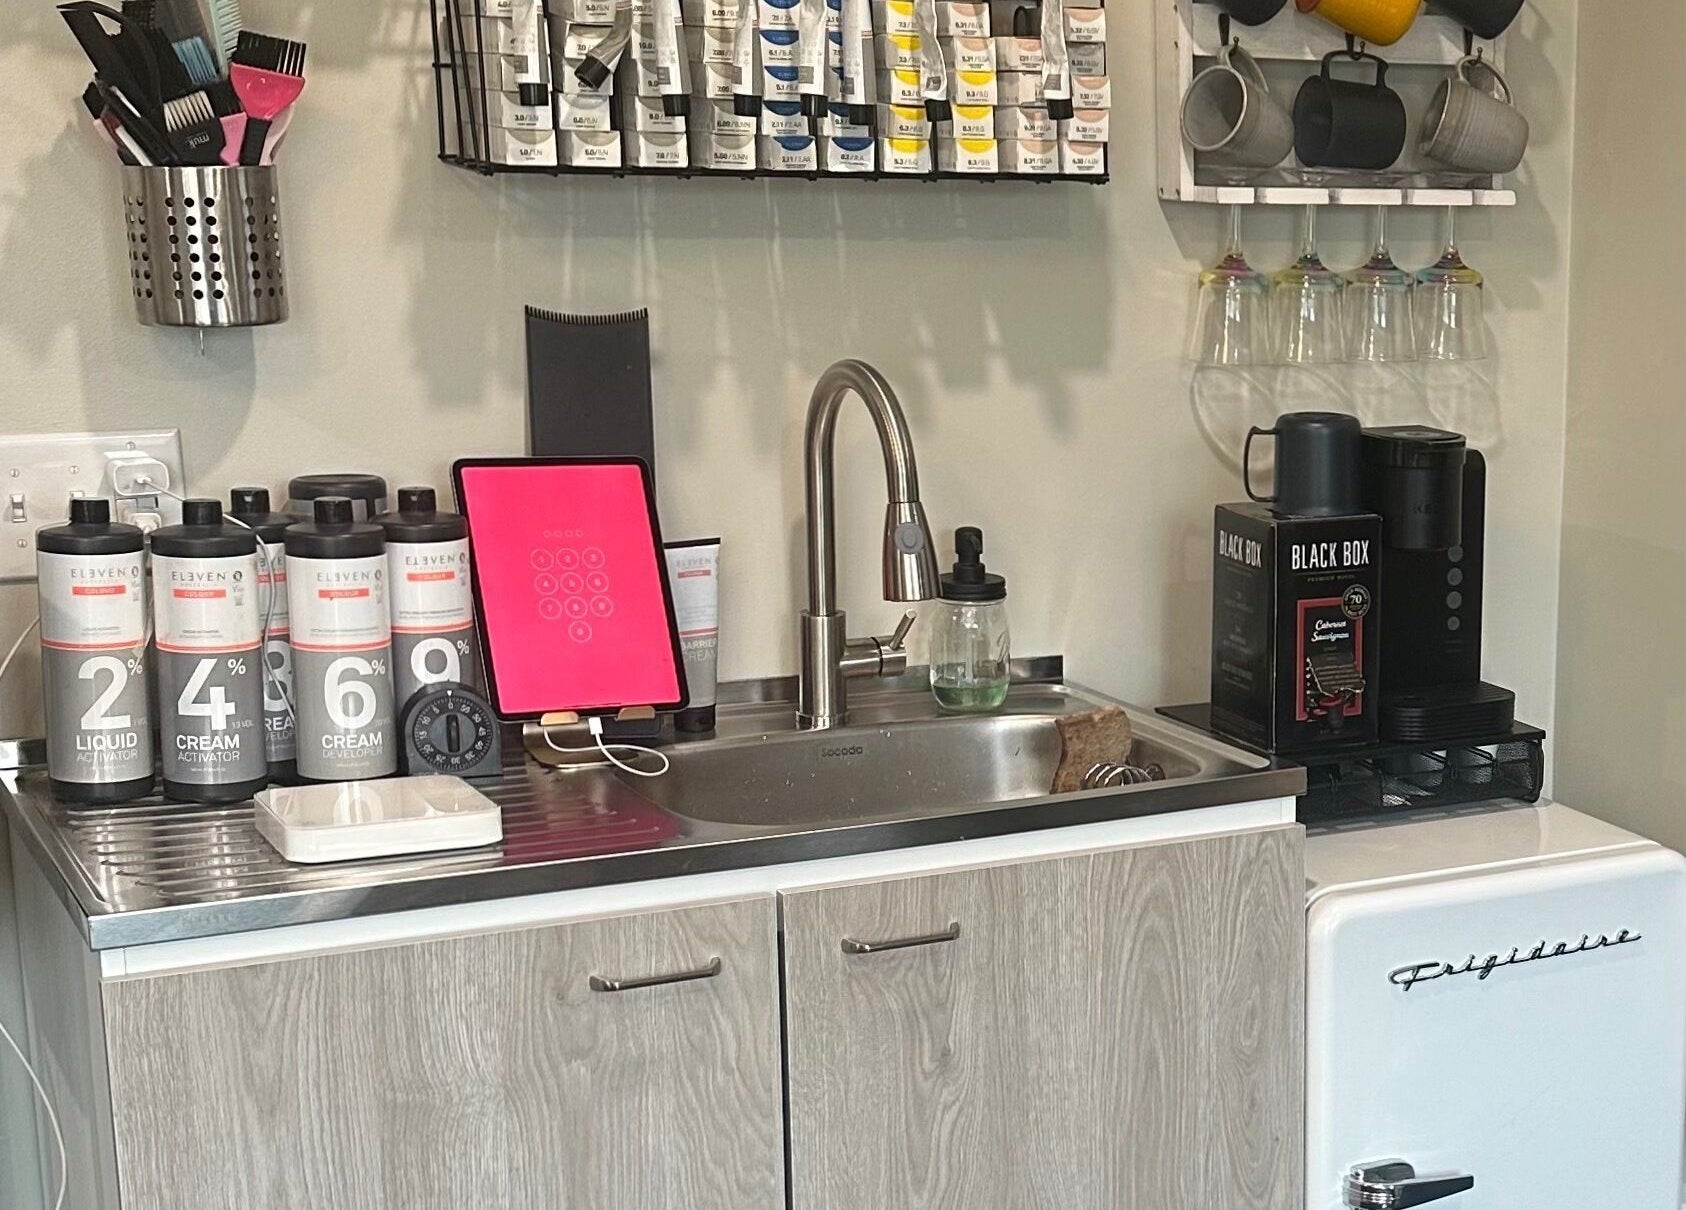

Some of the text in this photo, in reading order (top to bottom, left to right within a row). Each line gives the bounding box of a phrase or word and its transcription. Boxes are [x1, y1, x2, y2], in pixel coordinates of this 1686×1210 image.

[1219, 530, 1262, 568] BLACK BOX
[1291, 539, 1370, 570] BLACK BOX
[1350, 594, 1362, 605] 70
[264, 716, 294, 732] REA
[76, 732, 138, 751] LIQUID
[176, 733, 240, 751] CREAM
[321, 731, 383, 749] CREAM
[77, 749, 138, 763] ACTIVATOR
[178, 750, 240, 763] ACTIVATOR
[322, 746, 383, 759] DEVELOPER
[1387, 928, 1642, 992] Frigidaire
